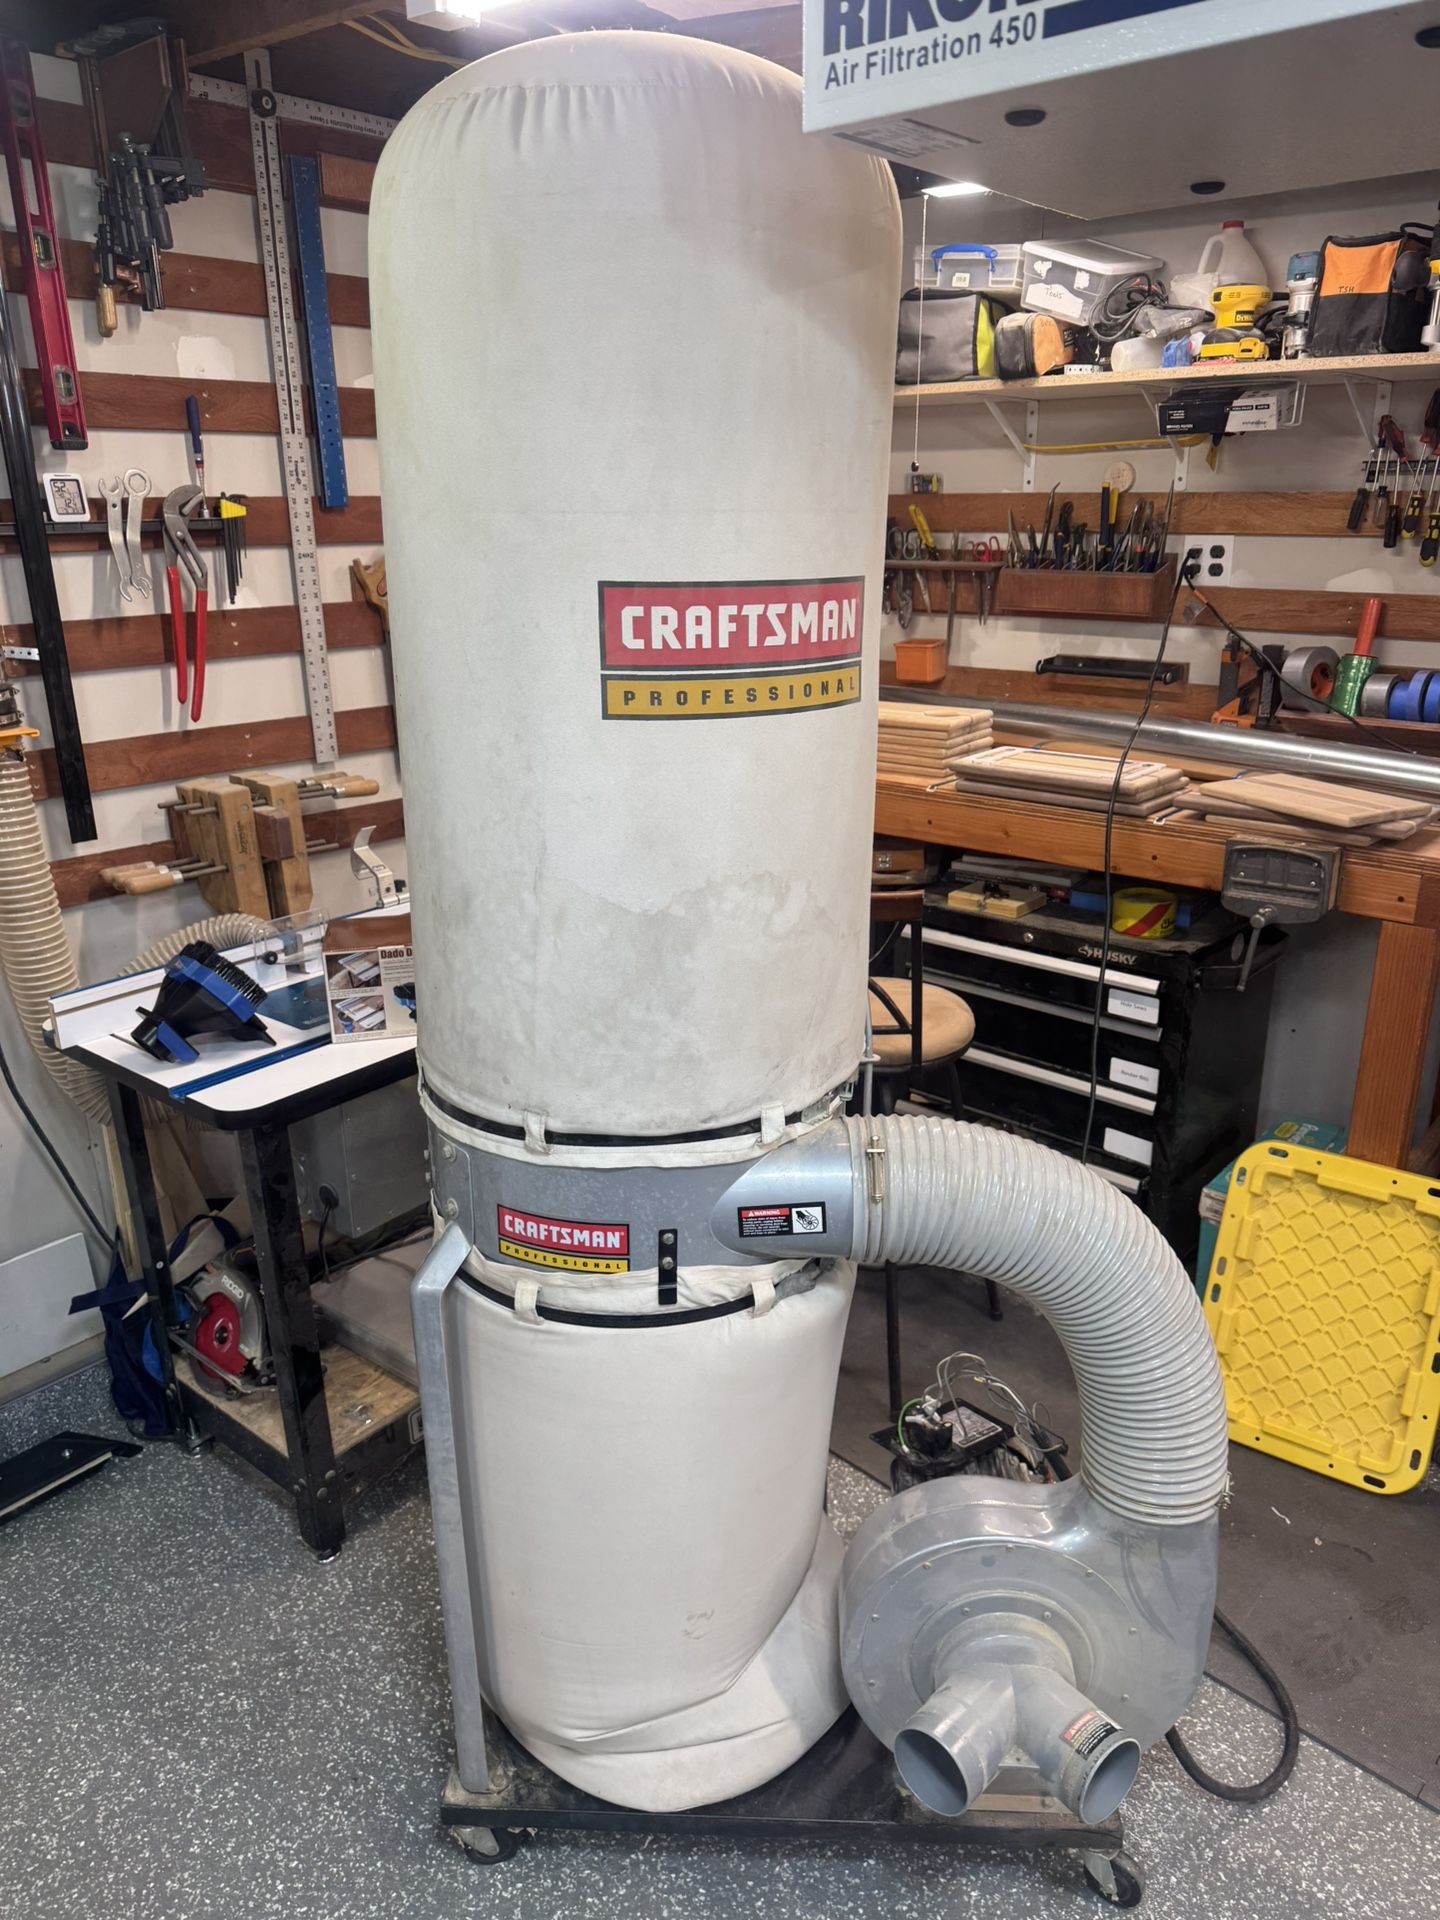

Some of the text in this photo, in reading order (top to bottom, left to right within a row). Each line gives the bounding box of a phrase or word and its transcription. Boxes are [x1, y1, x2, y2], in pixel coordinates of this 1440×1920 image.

[823, 0, 1040, 56] RIK
[825, 12, 1036, 90] Air Filtration 450
[1044, 287, 1063, 299] Tools
[53, 482, 66, 492] 52
[621, 599, 856, 650] CRAFTSMAN
[624, 676, 855, 706] PROFESSIONAL
[381, 947, 404, 959] Dado
[504, 1214, 621, 1248] CRAFTSMAN
[506, 1245, 621, 1269] PROFESSIONAL
[221, 1275, 244, 1299] RIDGID
